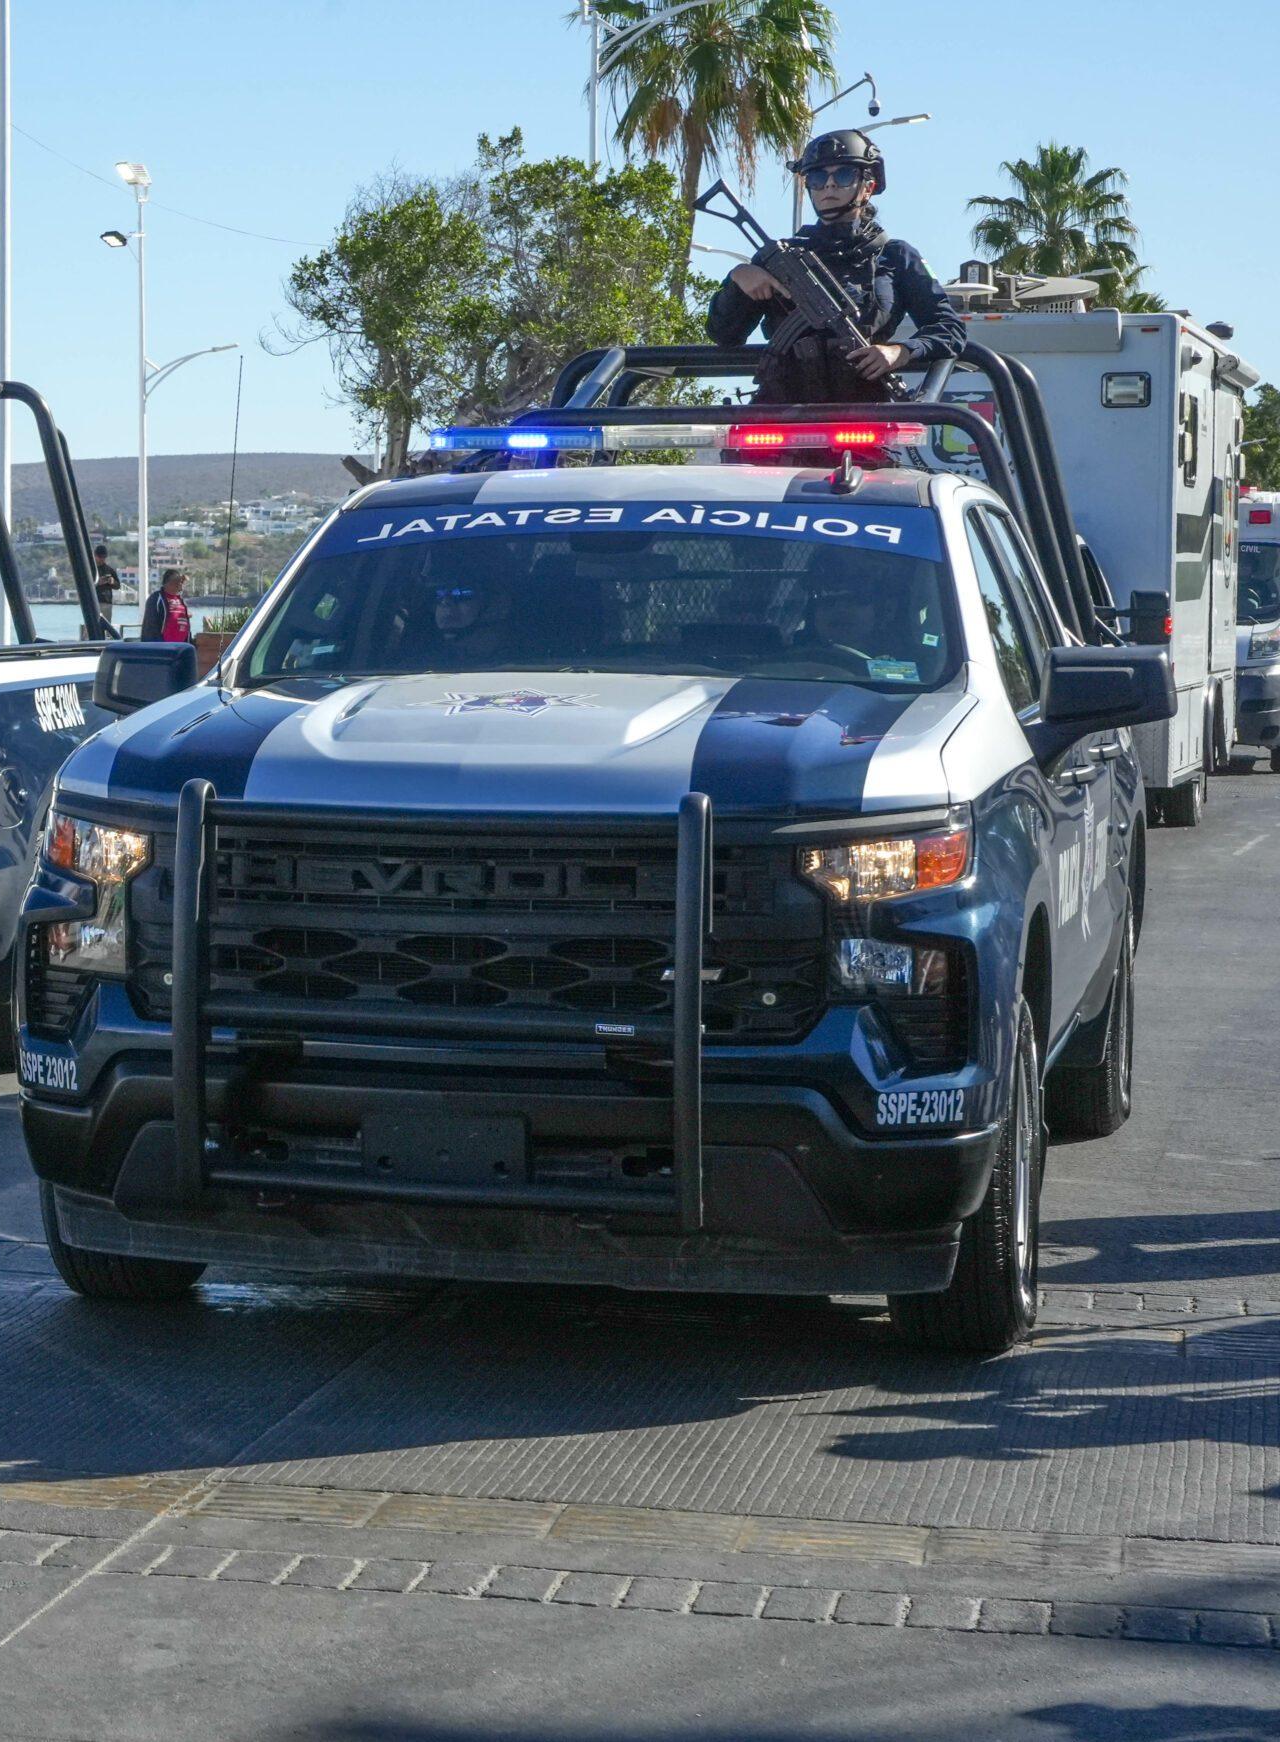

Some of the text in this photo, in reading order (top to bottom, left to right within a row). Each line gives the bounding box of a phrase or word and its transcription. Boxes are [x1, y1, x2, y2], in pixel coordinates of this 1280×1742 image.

[1240, 544, 1261, 553] CIVIL
[597, 1025, 632, 1033] THUNDER
[46, 1056, 78, 1090] 23012
[877, 1089, 964, 1125] SSPE-23012
